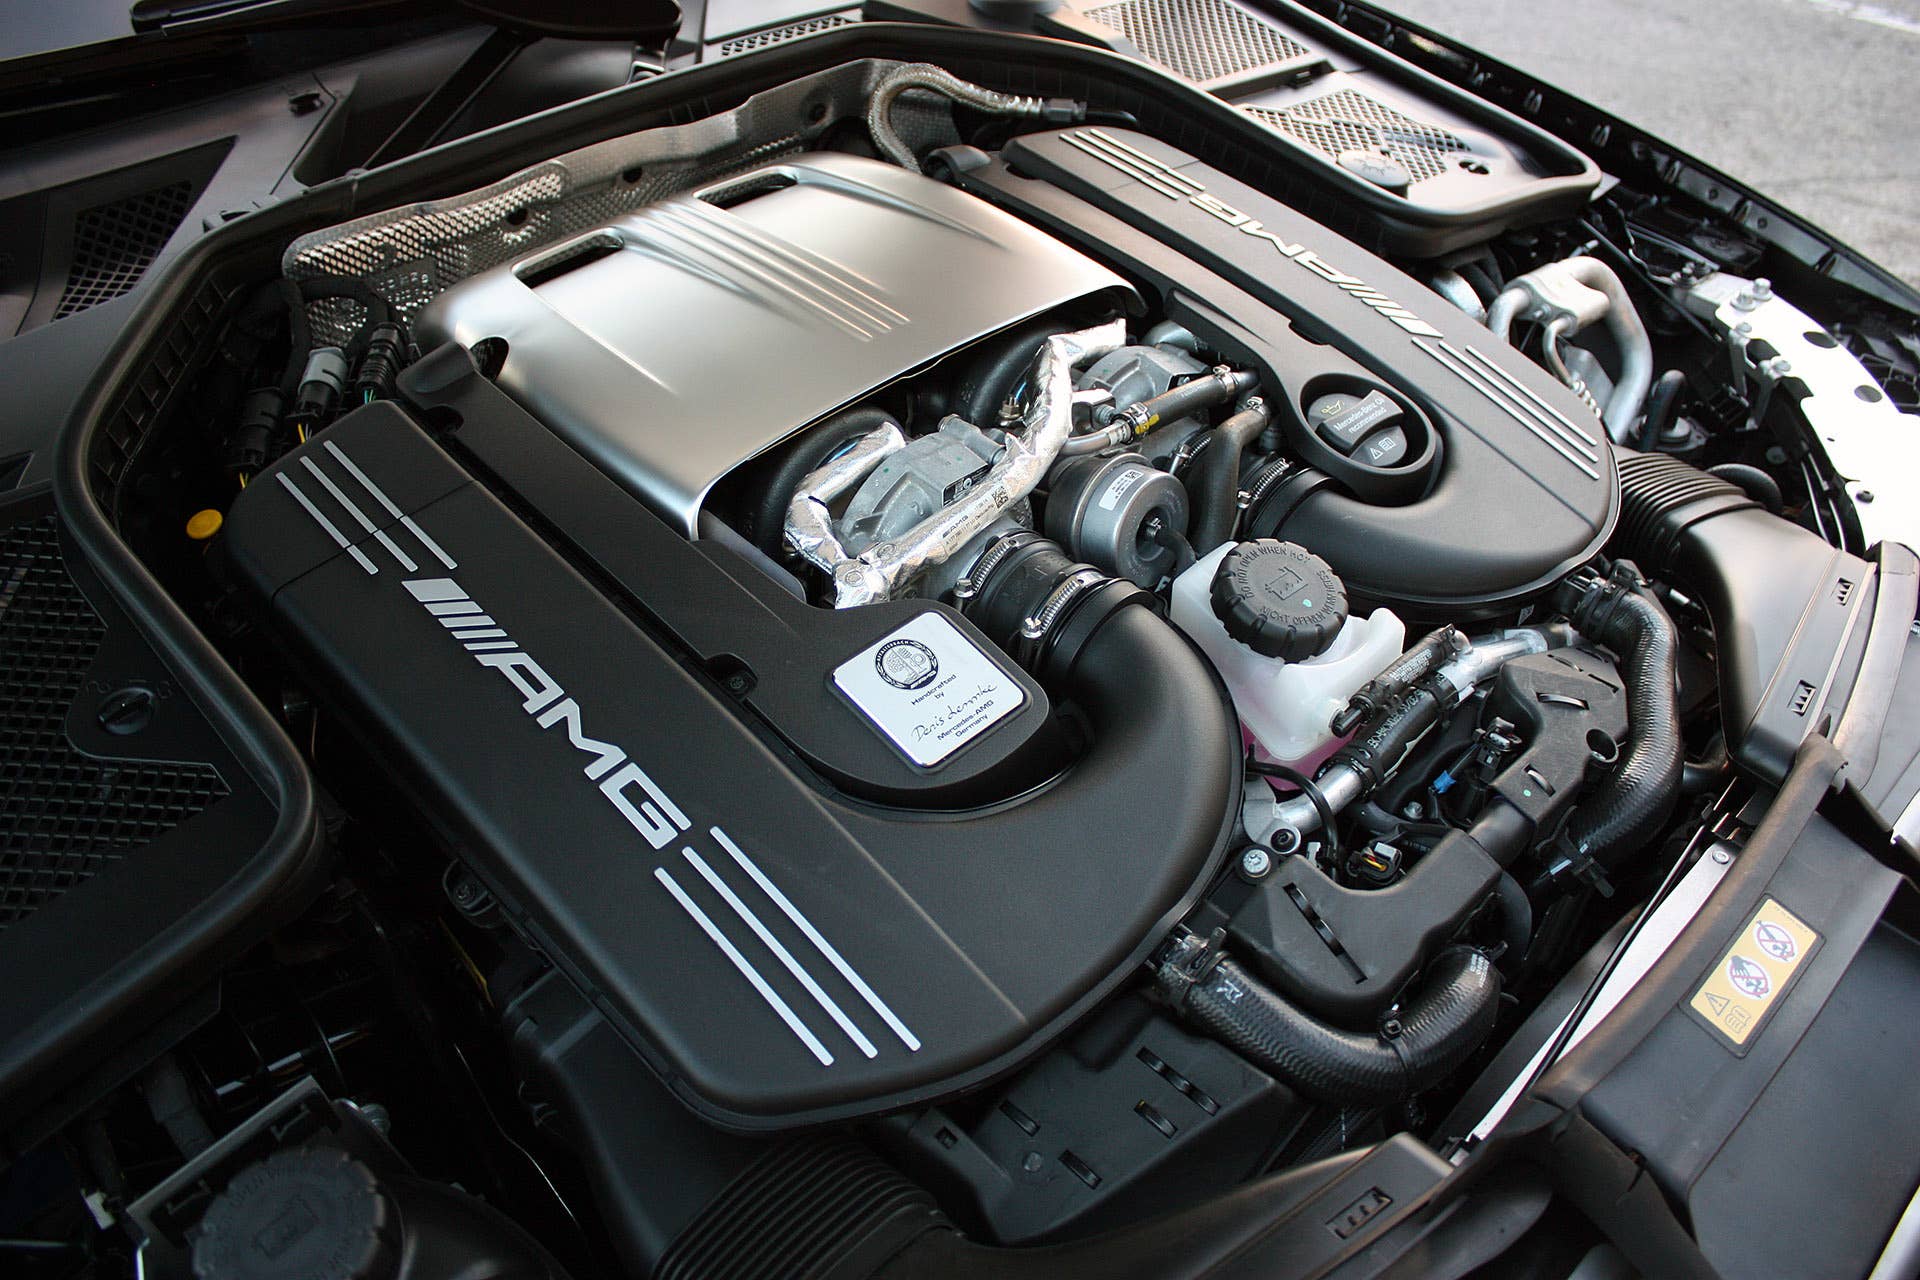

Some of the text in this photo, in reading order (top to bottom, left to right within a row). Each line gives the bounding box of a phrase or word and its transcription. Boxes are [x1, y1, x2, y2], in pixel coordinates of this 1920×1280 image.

[1189, 193, 1365, 285] AMG
[1259, 546, 1288, 556] WHEN
[911, 674, 957, 706] Handcrafted
[934, 691, 945, 700] by
[937, 700, 994, 741] Mercedes-AMG
[955, 713, 988, 738] Germany
[474, 652, 692, 850] AMG
